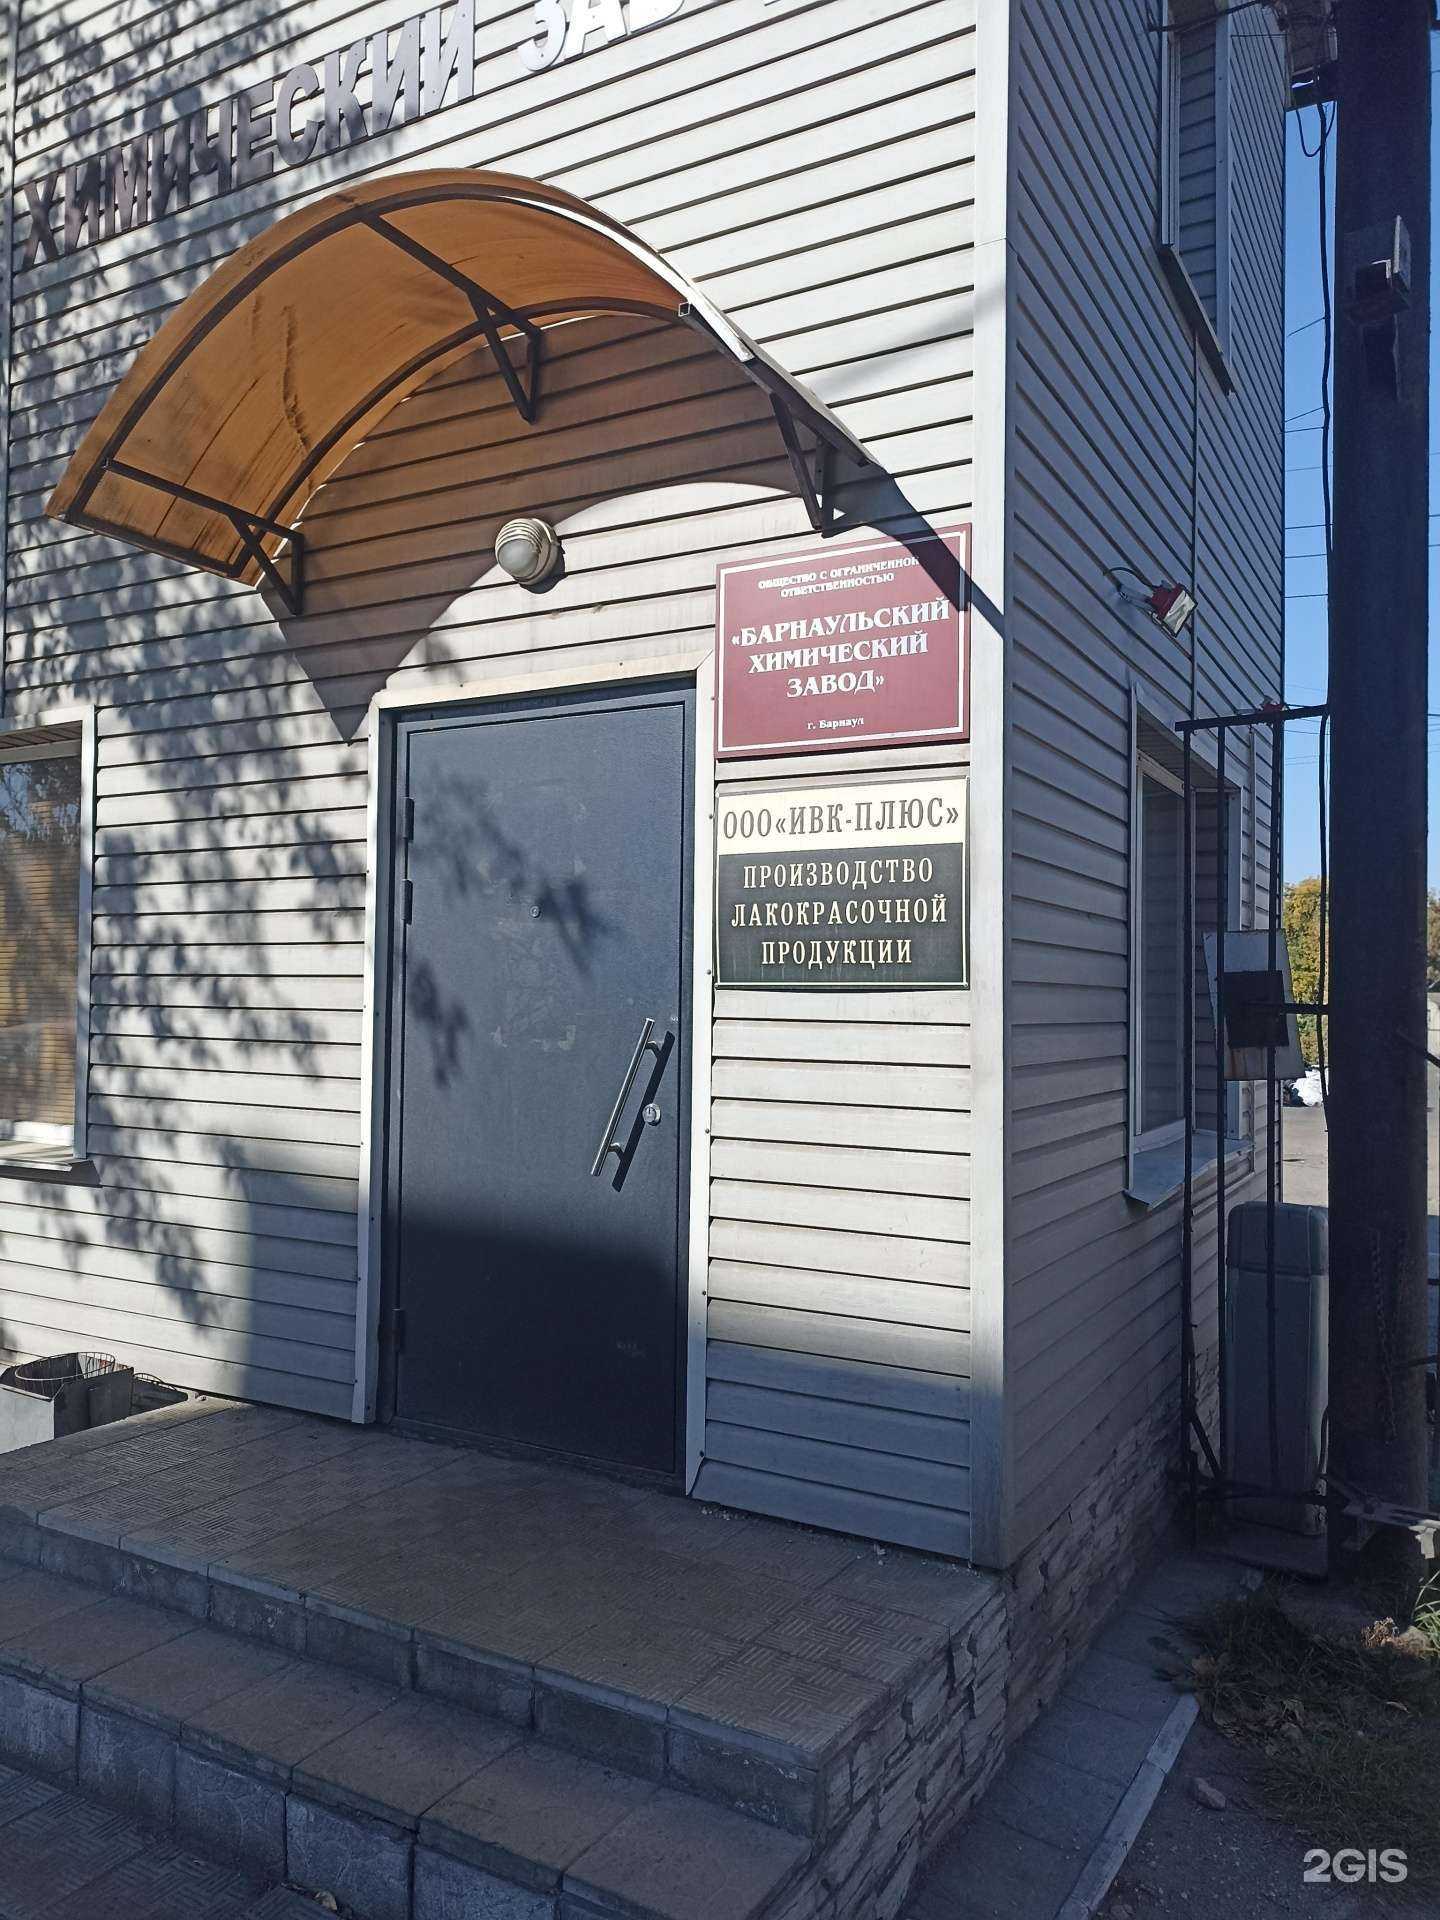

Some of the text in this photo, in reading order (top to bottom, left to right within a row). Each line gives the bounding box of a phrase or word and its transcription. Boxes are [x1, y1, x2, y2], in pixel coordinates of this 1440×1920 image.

[758, 572, 816, 590] ОБЩЕСТВО
[820, 571, 827, 580] С
[780, 572, 895, 598] ОТВЕТСТВЕННОСТЬЮ
[731, 596, 950, 647] «БАРНАУЛЬСКИЙ
[748, 630, 928, 674] ХИМИЧЕСКИЙ
[786, 669, 884, 698] ЗАВОД»
[807, 717, 864, 730] г. Барнаул
[743, 857, 933, 890] ПРОИЗВОДСТВО
[731, 893, 947, 928] ЛАКОКРАСОЧНОЙ
[761, 939, 912, 970] ПРОДУКЦИИ
